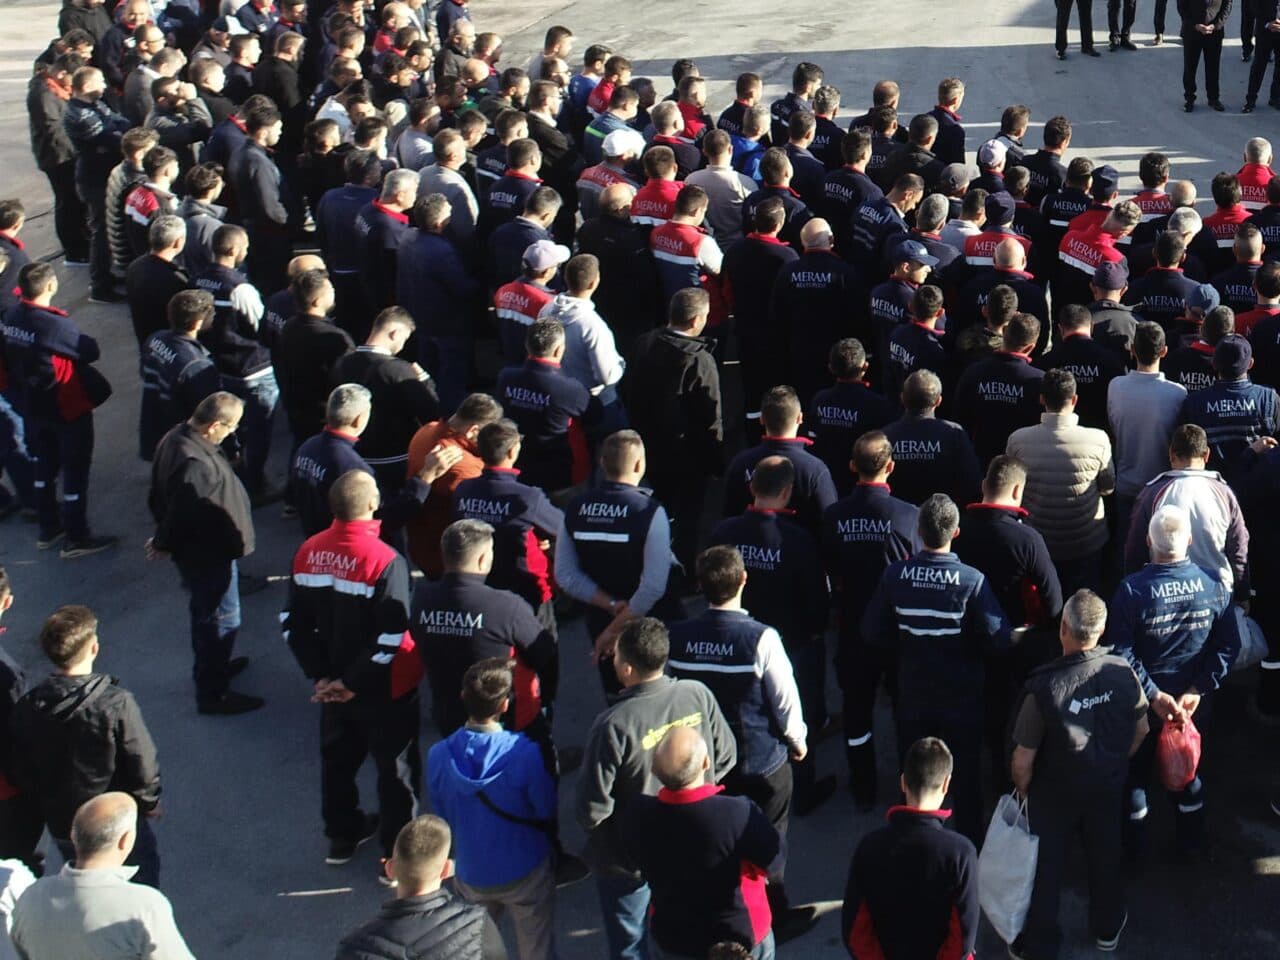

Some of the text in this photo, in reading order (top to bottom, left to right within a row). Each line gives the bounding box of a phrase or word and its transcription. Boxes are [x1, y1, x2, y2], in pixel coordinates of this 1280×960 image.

[825, 182, 853, 199] MERAM
[637, 201, 667, 212] MERAM
[1053, 201, 1087, 211] MERAM
[859, 206, 884, 223] MERAM
[656, 236, 683, 250] MERAM
[974, 241, 997, 251] MER
[1067, 238, 1102, 262] MERAM
[791, 272, 831, 283] MERAM
[1225, 285, 1257, 296] MERA
[871, 297, 904, 318] MERAM
[1143, 296, 1186, 307] MERAM
[3, 325, 35, 343] MERAM
[150, 338, 176, 362] MERAM
[505, 386, 550, 405] MERAM
[978, 382, 1024, 397] MERAM
[817, 406, 857, 422] MERAM
[1207, 400, 1256, 413] MERAM
[892, 440, 941, 454] MERAM
[458, 498, 509, 515] MERAM
[579, 504, 628, 517] MERAM
[837, 520, 891, 534] MERAM
[307, 551, 357, 570] MERAM
[740, 545, 782, 562] ERAM
[901, 567, 960, 585] MERAM
[1151, 578, 1203, 599] MERAM
[420, 610, 483, 629] MERAM
[426, 626, 473, 637] BELEDİYESİ
[686, 642, 734, 656] MERAM
[1082, 691, 1112, 710] Spark
